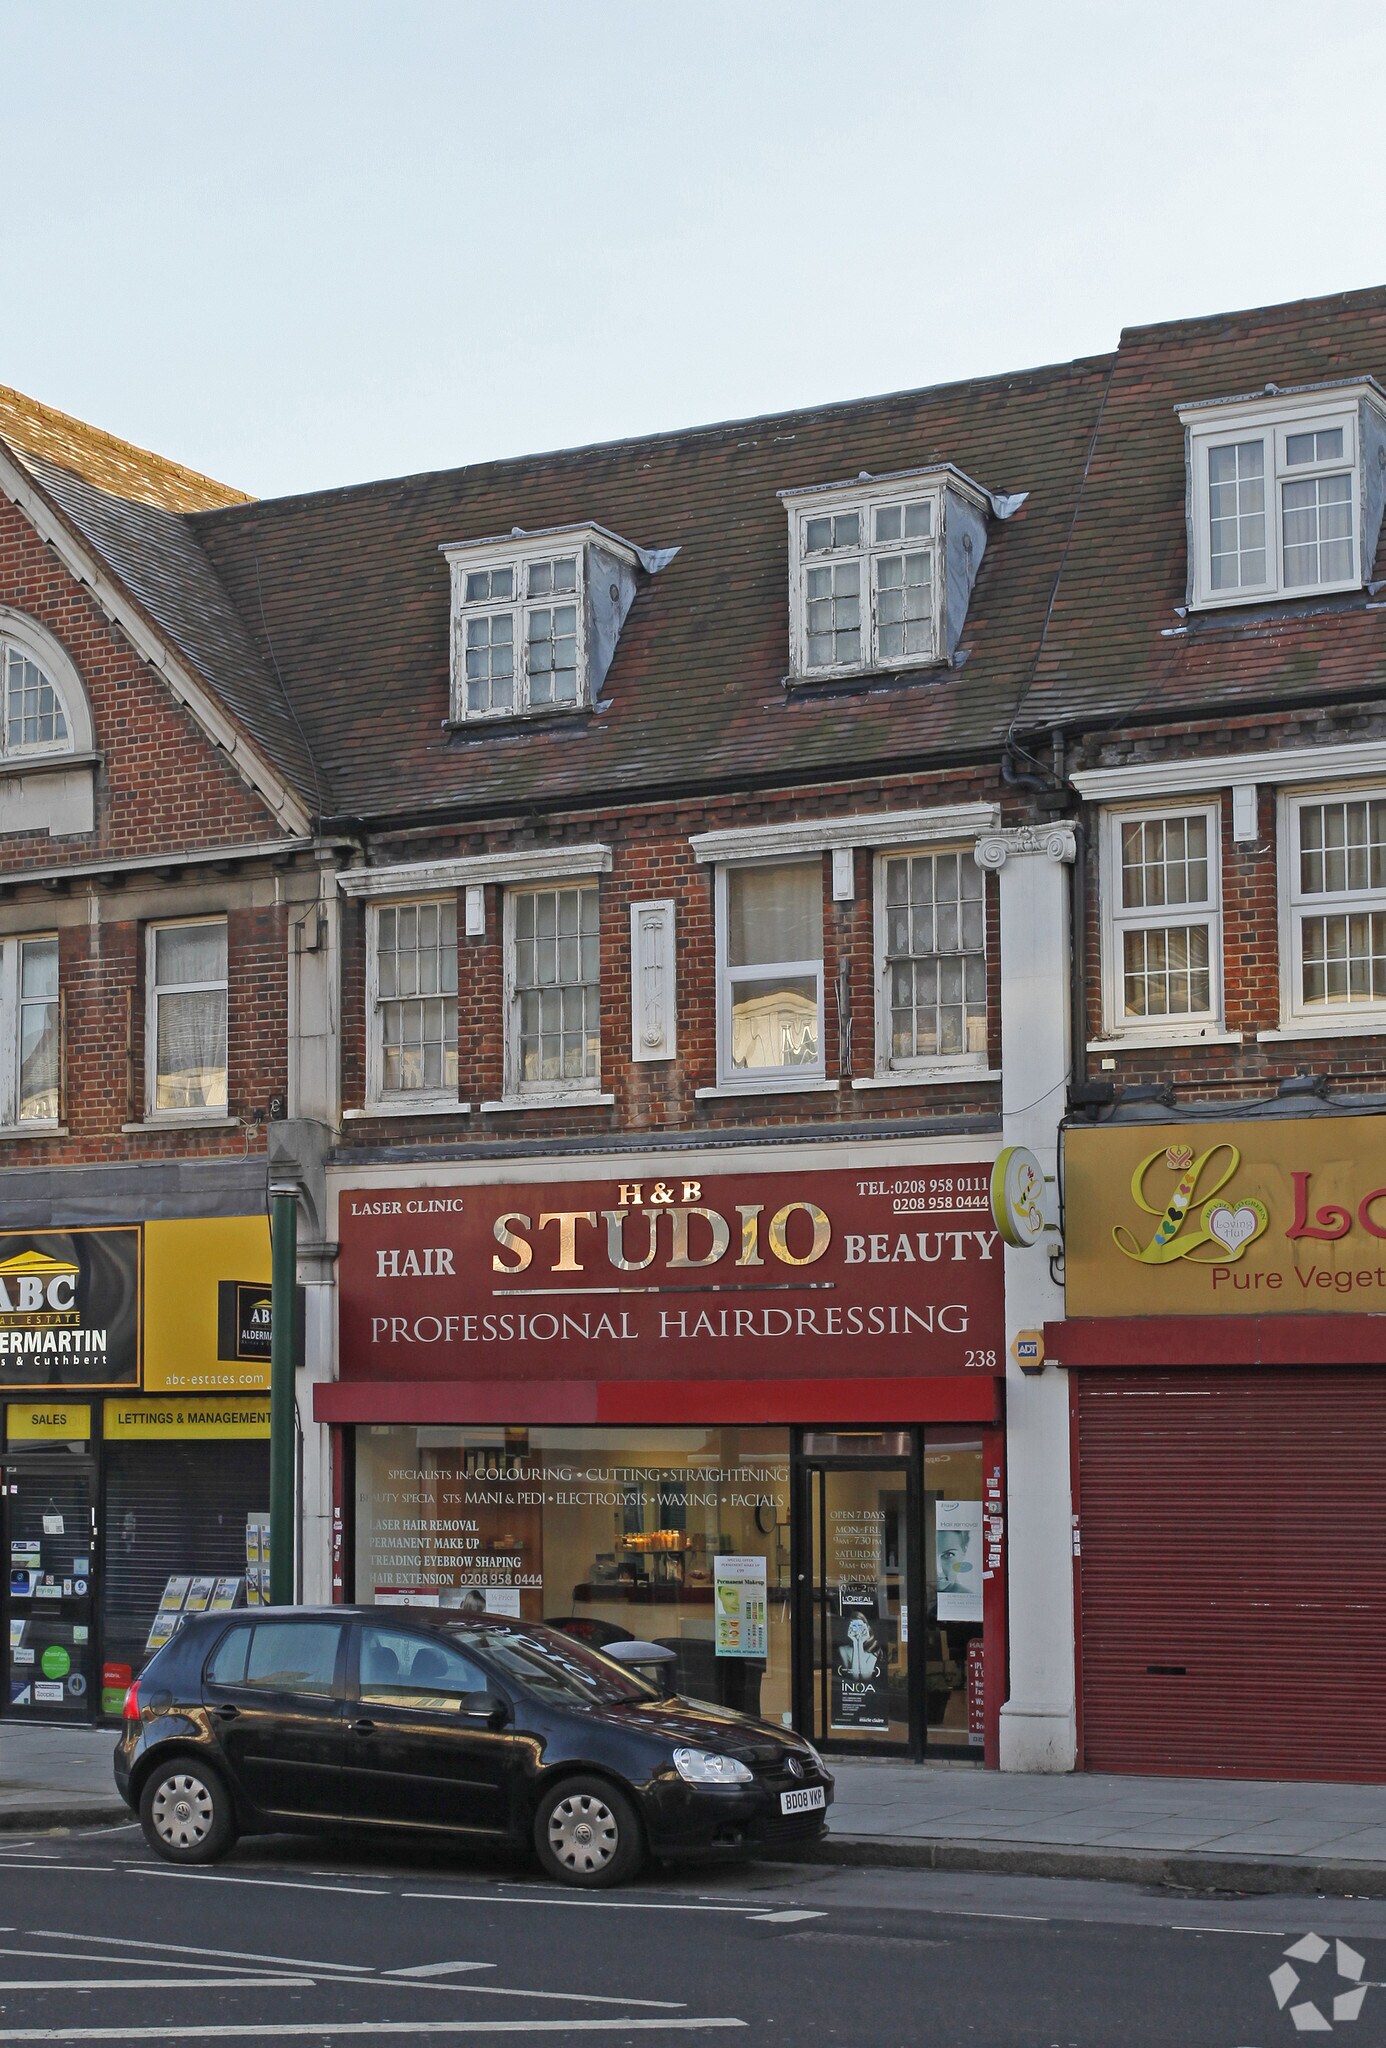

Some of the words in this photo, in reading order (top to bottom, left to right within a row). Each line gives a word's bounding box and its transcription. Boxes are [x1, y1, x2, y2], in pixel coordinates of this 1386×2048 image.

[857, 1180, 926, 1196] TEL:0208
[929, 1178, 954, 1193] 958
[956, 1176, 989, 1191] 0111
[351, 1202, 402, 1216] LASER
[406, 1198, 464, 1213] CLINIC
[893, 1197, 925, 1211] 0208
[928, 1196, 953, 1210] 958
[956, 1195, 989, 1209] 0444
[1216, 1220, 1253, 1230] Loving
[492, 1202, 832, 1274] STUDIO
[844, 1230, 999, 1264] BEAUTY
[376, 1248, 456, 1277] HAIR
[1212, 1267, 1283, 1290] Pure
[1294, 1265, 1386, 1293] Veget
[26, 1314, 80, 1324] ESTATE
[251, 1308, 272, 1323] AB
[371, 1312, 639, 1343] PROFESSIONAL
[659, 1304, 970, 1338] HAIRDRESSING
[1018, 1344, 1037, 1354] ADT
[16, 1356, 24, 1366] &
[34, 1355, 107, 1366] Cuthbert
[964, 1350, 997, 1367] 238
[165, 1373, 264, 1385] abc-estates.com
[31, 1414, 67, 1425] SALES
[118, 1413, 173, 1425] LETTINGS
[176, 1413, 184, 1424] &
[388, 1470, 451, 1480] SPECIALISTS
[456, 1471, 472, 1480] IN:
[475, 1468, 572, 1481] COLOURING
[586, 1468, 660, 1481] CUTTING
[670, 1468, 789, 1482] STRAIGHTENING
[465, 1492, 503, 1504] MANI
[505, 1493, 514, 1504] &
[517, 1493, 545, 1505] PEDI
[556, 1493, 648, 1506] ELECTROLYSIS
[657, 1493, 718, 1506] WAXING
[731, 1494, 784, 1507] FACIALS
[830, 1511, 855, 1519] OPEN
[857, 1511, 862, 1519] 7
[863, 1511, 886, 1519] DAYS
[369, 1519, 400, 1531] LASER
[403, 1519, 427, 1531] HAIR
[430, 1520, 479, 1531] REMOVAL
[369, 1537, 431, 1549] PERMANENT
[434, 1538, 464, 1550] MAKE
[466, 1538, 480, 1550] UP
[835, 1550, 881, 1558] SATURDAY
[424, 1556, 473, 1567] EYEBROW
[475, 1556, 521, 1568] SHAPING
[369, 1573, 395, 1585] HAIR
[396, 1573, 454, 1585] EXTENSION
[460, 1574, 487, 1585] 0208
[489, 1574, 513, 1585] 958
[514, 1574, 543, 1586] 0444
[839, 1574, 877, 1582] SUNDAY
[785, 1792, 808, 1809] BD08
[809, 1789, 822, 1806] VKP
